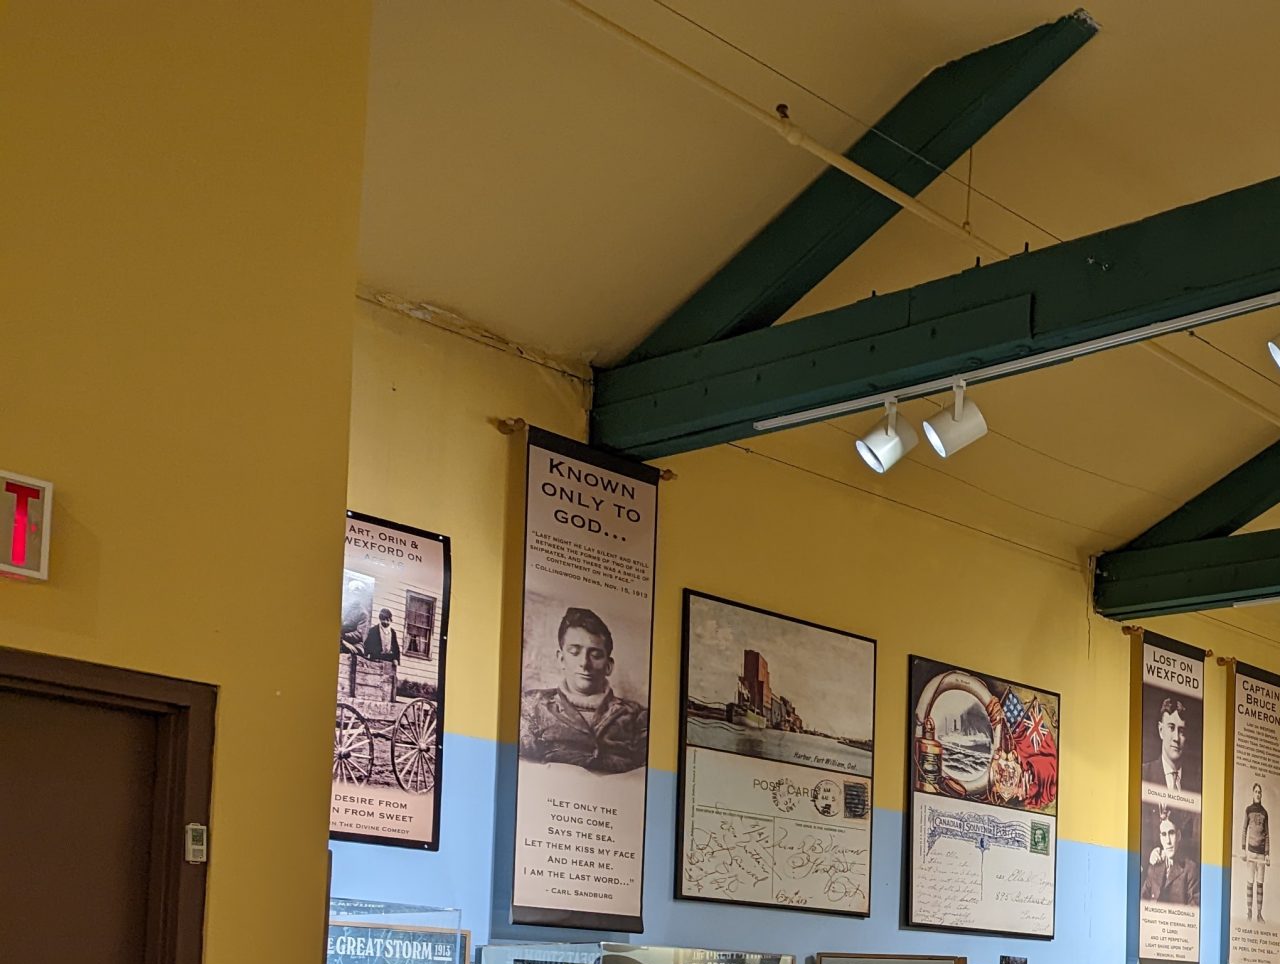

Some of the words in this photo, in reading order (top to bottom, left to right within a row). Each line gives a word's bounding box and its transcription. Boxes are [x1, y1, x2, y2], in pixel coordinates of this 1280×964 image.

[550, 458, 635, 500] KNOWN
[541, 482, 604, 512] ONLY
[613, 503, 641, 523] TO
[554, 509, 626, 541] GOD...
[349, 524, 374, 540] ART,
[378, 532, 407, 546] ORIN
[410, 540, 419, 550] &
[407, 553, 422, 563] ON
[535, 563, 581, 581] COLLINGWOOD
[1153, 651, 1177, 669] LOST
[1180, 661, 1193, 674] ON
[1146, 663, 1199, 690] WEXFORD
[1242, 680, 1280, 702] CAPTAIN
[1246, 694, 1276, 712] BRUCE
[334, 794, 375, 806] DESIRE
[378, 799, 407, 810] FROM
[573, 802, 598, 812] ONLY
[600, 806, 618, 815] THE
[344, 808, 375, 818] FROM
[379, 812, 414, 823] SWEET
[551, 813, 583, 825] YOUNG
[586, 818, 614, 830] COME,
[355, 823, 380, 832] DIVINE
[381, 826, 410, 835] COMEDY
[548, 827, 572, 837] SAYS
[576, 831, 592, 840] THE
[596, 835, 615, 843] SEA.
[524, 838, 543, 848] LET
[546, 842, 571, 851] THEM
[575, 846, 594, 854] KISS
[597, 848, 611, 857] MY
[613, 850, 635, 860] FACE
[547, 855, 568, 865] AND
[571, 859, 594, 868] HEAR
[598, 862, 613, 870] ME.
[530, 869, 544, 877] AM
[547, 870, 565, 879] THE
[569, 873, 591, 881] LAST
[551, 888, 572, 896] CARL
[574, 890, 613, 900] SANDBURG
[335, 936, 384, 957] GREAT
[385, 939, 432, 960] STORM
